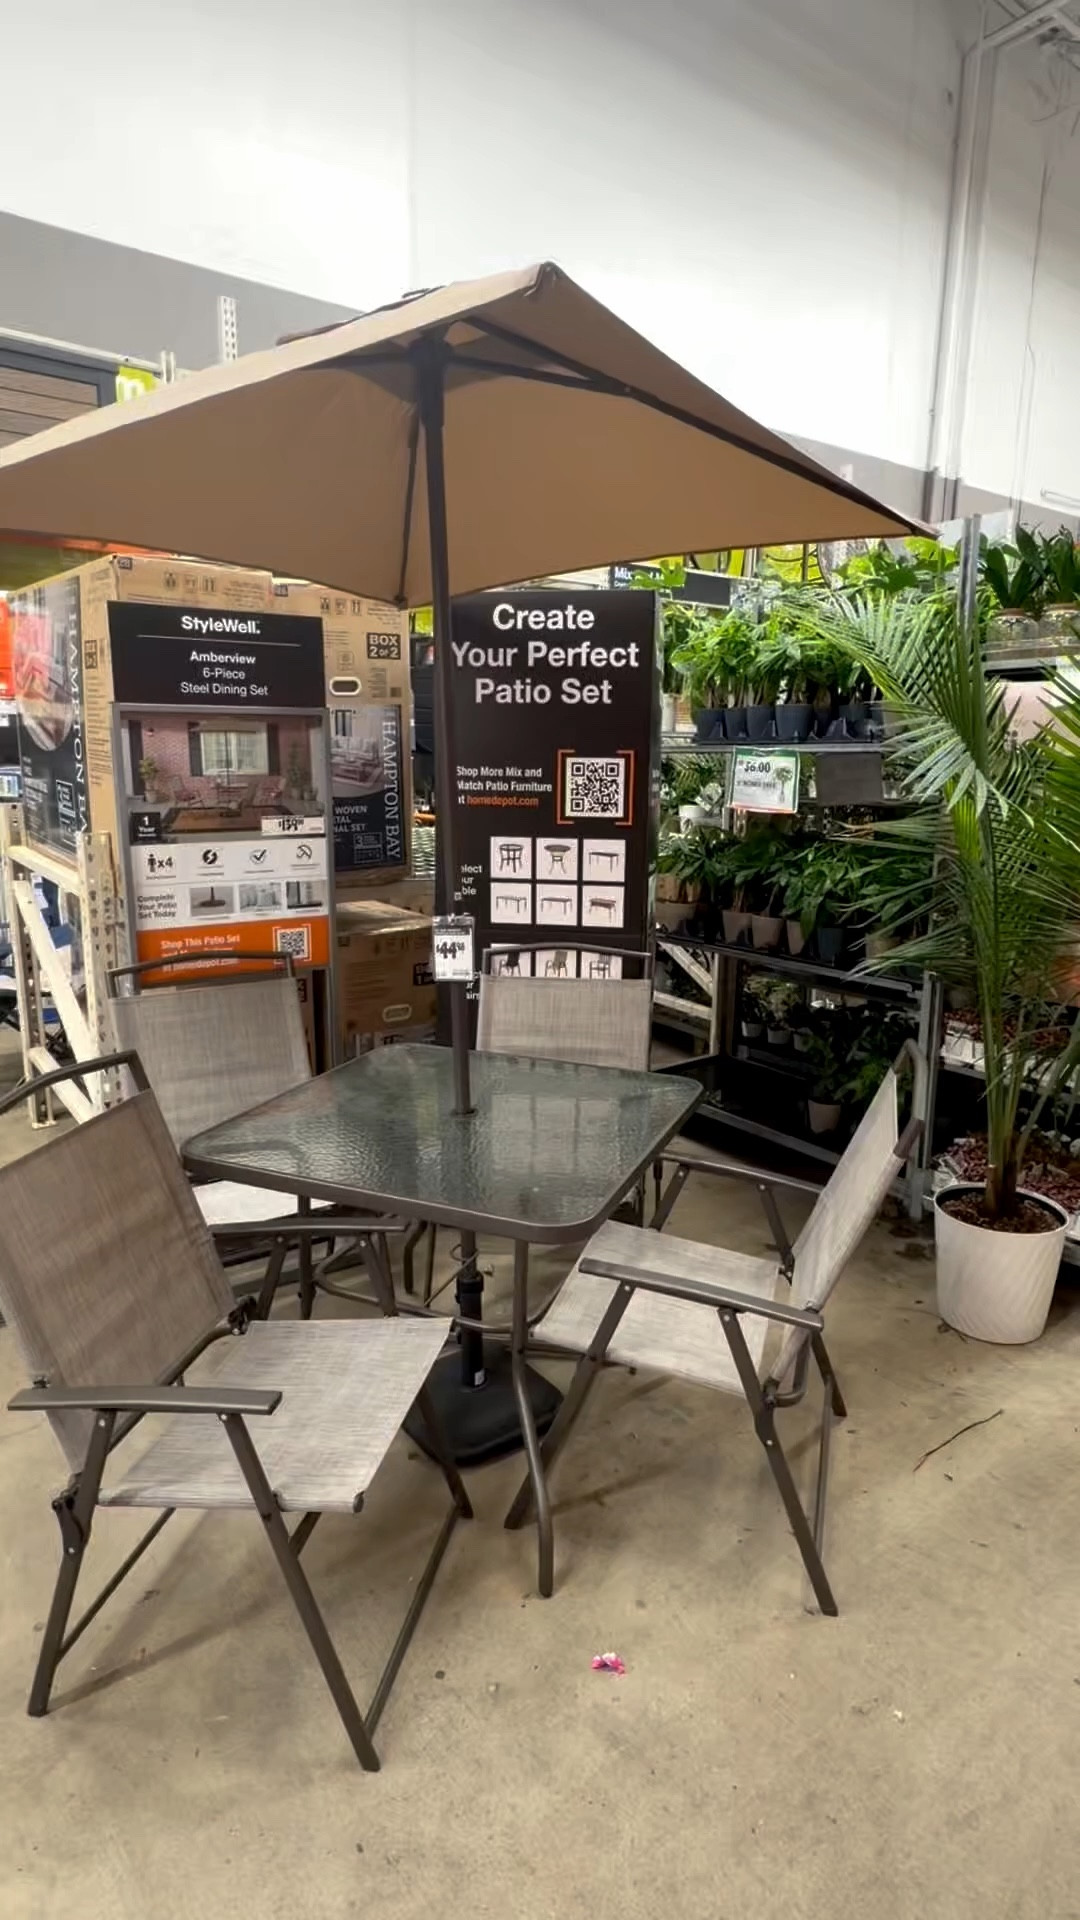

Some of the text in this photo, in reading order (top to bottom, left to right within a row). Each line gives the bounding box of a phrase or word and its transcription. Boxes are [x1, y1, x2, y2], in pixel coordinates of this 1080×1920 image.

[492, 603, 595, 630] Create
[369, 634, 399, 646] BOX
[190, 651, 256, 664] Amberview
[369, 646, 378, 658] 2
[390, 647, 399, 658] 2
[451, 641, 640, 667] Your Perfect
[203, 667, 246, 680] 6-Piece
[180, 681, 268, 697] Steel Dining Set
[475, 678, 612, 704] Patio Set
[456, 766, 542, 778] Shop More Mix and
[382, 721, 400, 858] HAMPTON BAY
[485, 781, 509, 791] Patio
[511, 781, 552, 791] Furniture
[467, 795, 539, 807] homedepot.com
[335, 805, 368, 815] WOVEN
[143, 816, 149, 826] 1
[351, 824, 366, 832] SET
[160, 934, 241, 950] Shop This Patio Set
